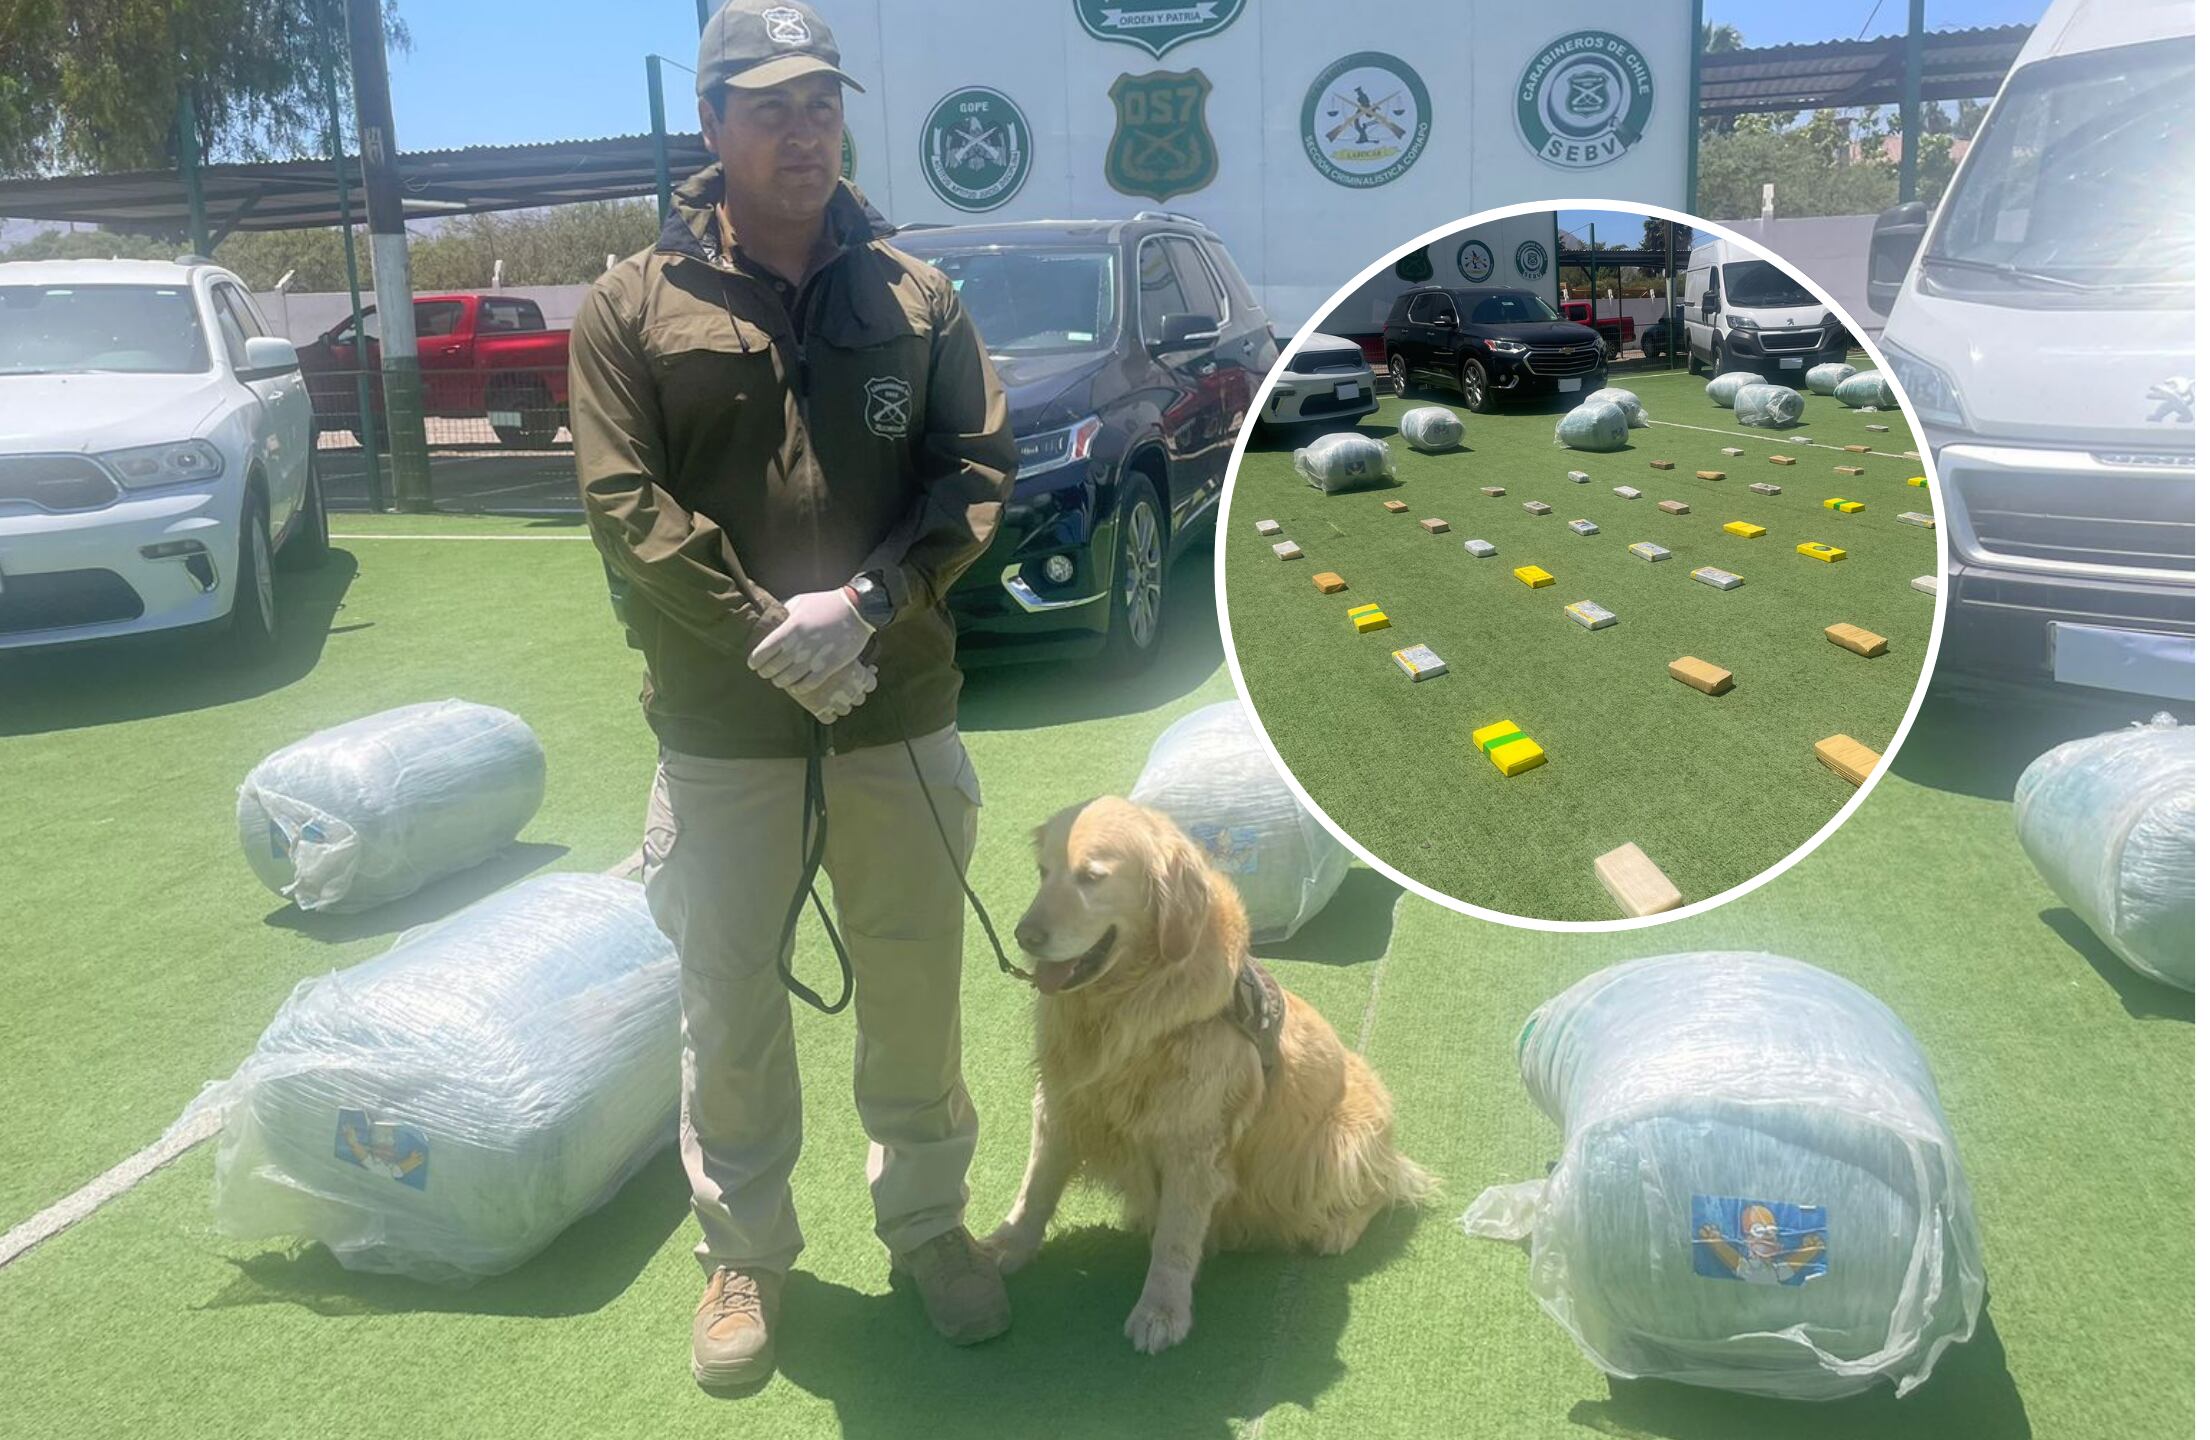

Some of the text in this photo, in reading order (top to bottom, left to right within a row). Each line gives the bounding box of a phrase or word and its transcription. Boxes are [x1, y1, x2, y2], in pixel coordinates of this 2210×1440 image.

[1120, 10, 1201, 26] ORDEN Y PATRIA
[1522, 36, 1651, 102] CARABINEROS DE CHILE
[959, 101, 990, 113] GOPE
[1548, 137, 1616, 162] SEBV
